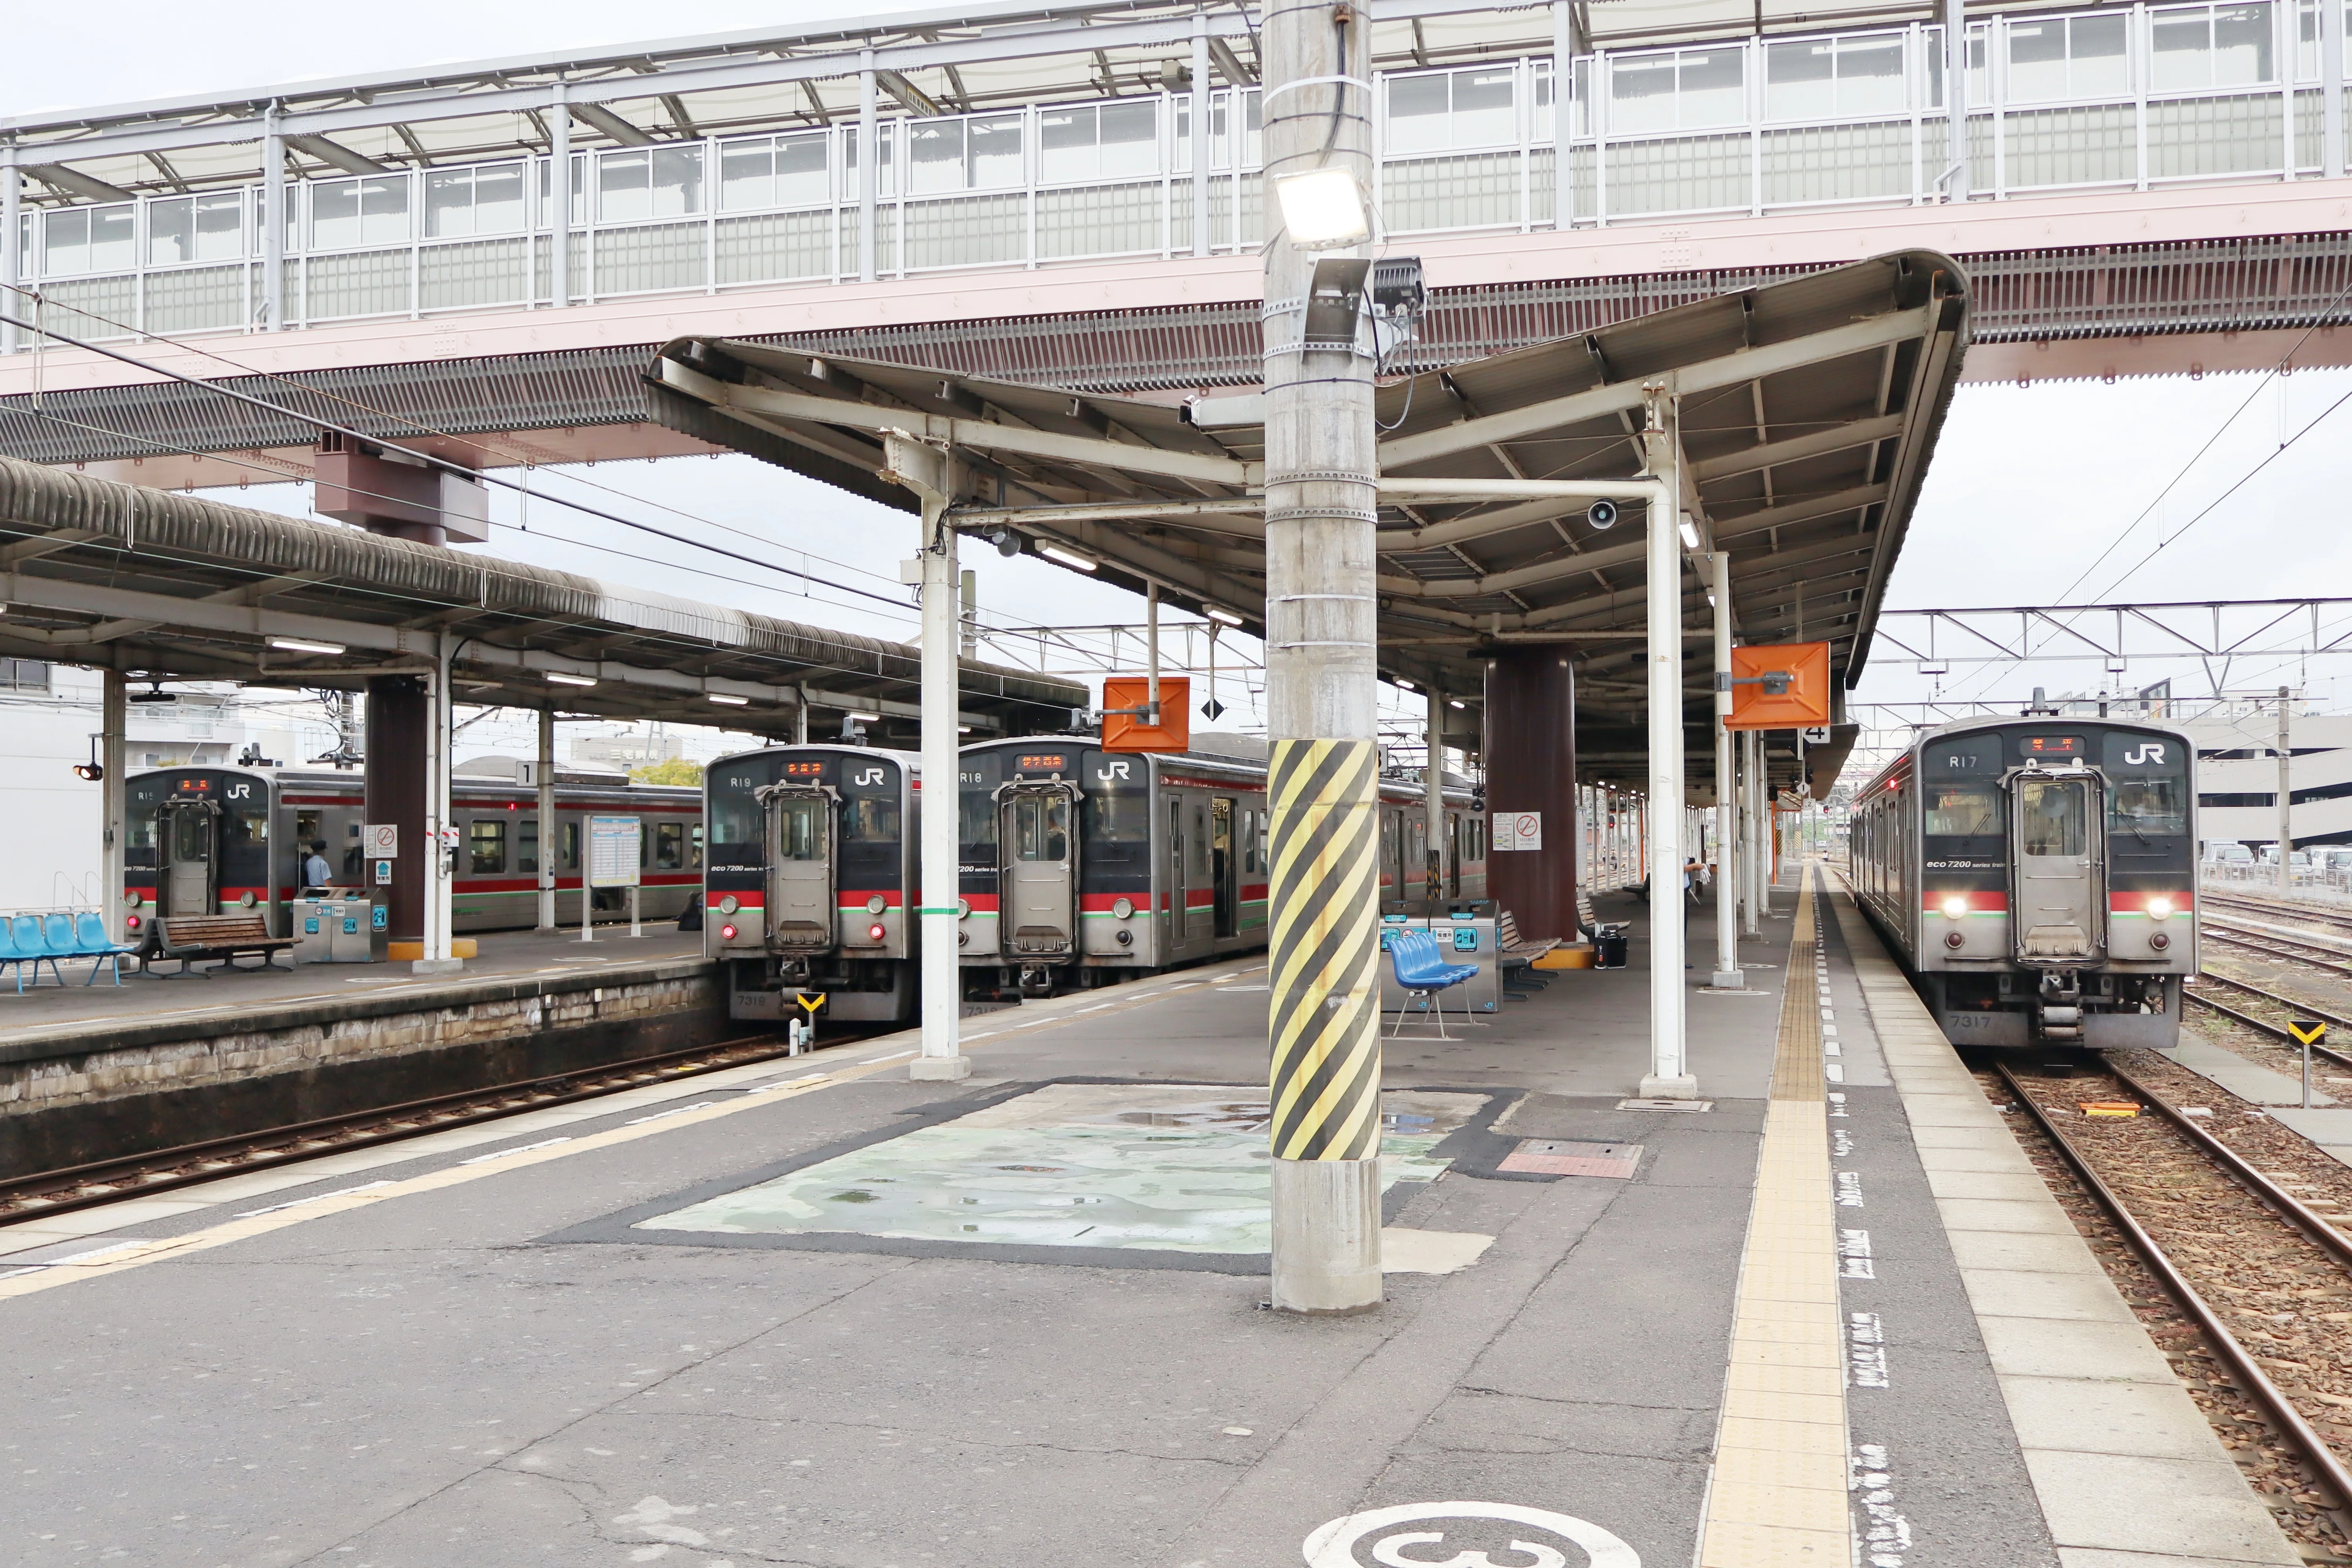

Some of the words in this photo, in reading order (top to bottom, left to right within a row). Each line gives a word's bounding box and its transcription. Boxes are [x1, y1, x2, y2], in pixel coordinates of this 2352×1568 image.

[1805, 727, 1825, 739] 4
[2124, 743, 2165, 765] JR
[1022, 756, 1062, 766] 伊予西条
[1949, 756, 1977, 768] R17
[523, 764, 530, 783] 1
[855, 768, 884, 786] JR
[1097, 761, 1130, 780] JR
[731, 778, 751, 787] R19
[960, 772, 982, 783] R18
[227, 784, 250, 799] JR
[1950, 1015, 1991, 1028] 7317
